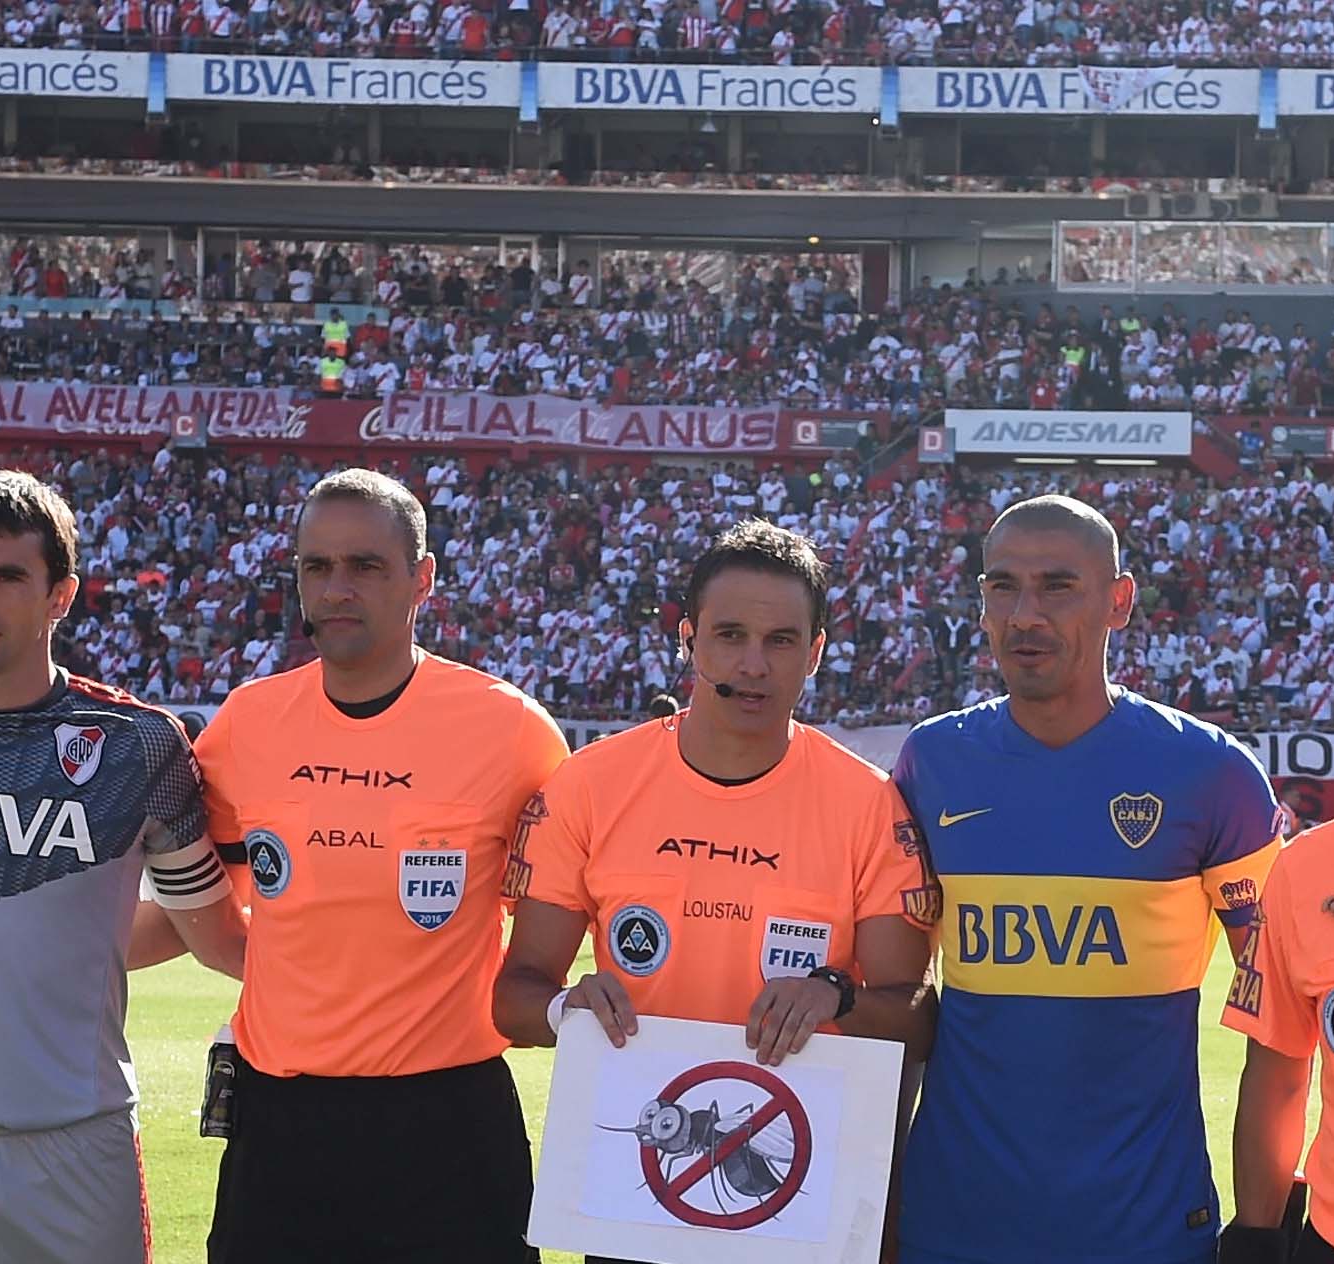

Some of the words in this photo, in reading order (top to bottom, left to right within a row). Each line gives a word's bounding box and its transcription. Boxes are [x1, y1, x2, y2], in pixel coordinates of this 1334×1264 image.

[203, 59, 316, 97] BBVA
[326, 60, 488, 101] Francés
[574, 67, 686, 104] BBVA
[697, 69, 857, 107] Francés
[935, 71, 1048, 108] BBVA
[1059, 70, 1222, 110] Fcés
[175, 414, 194, 436] C
[386, 394, 553, 438] FILIAL
[579, 407, 775, 449] LANUS
[971, 420, 1167, 444] ANDESMAR
[923, 430, 942, 451] D
[291, 765, 413, 789] ATHIX
[307, 829, 385, 849] ABAL
[404, 855, 463, 867] REFEREE
[656, 837, 781, 870] ATHIX
[407, 879, 457, 898] FIFA
[419, 913, 443, 924] 2016
[683, 900, 754, 922] LOUSTAU
[769, 922, 828, 940] REFEREE
[958, 904, 1128, 966] BBVA
[768, 947, 819, 969] FIFA
